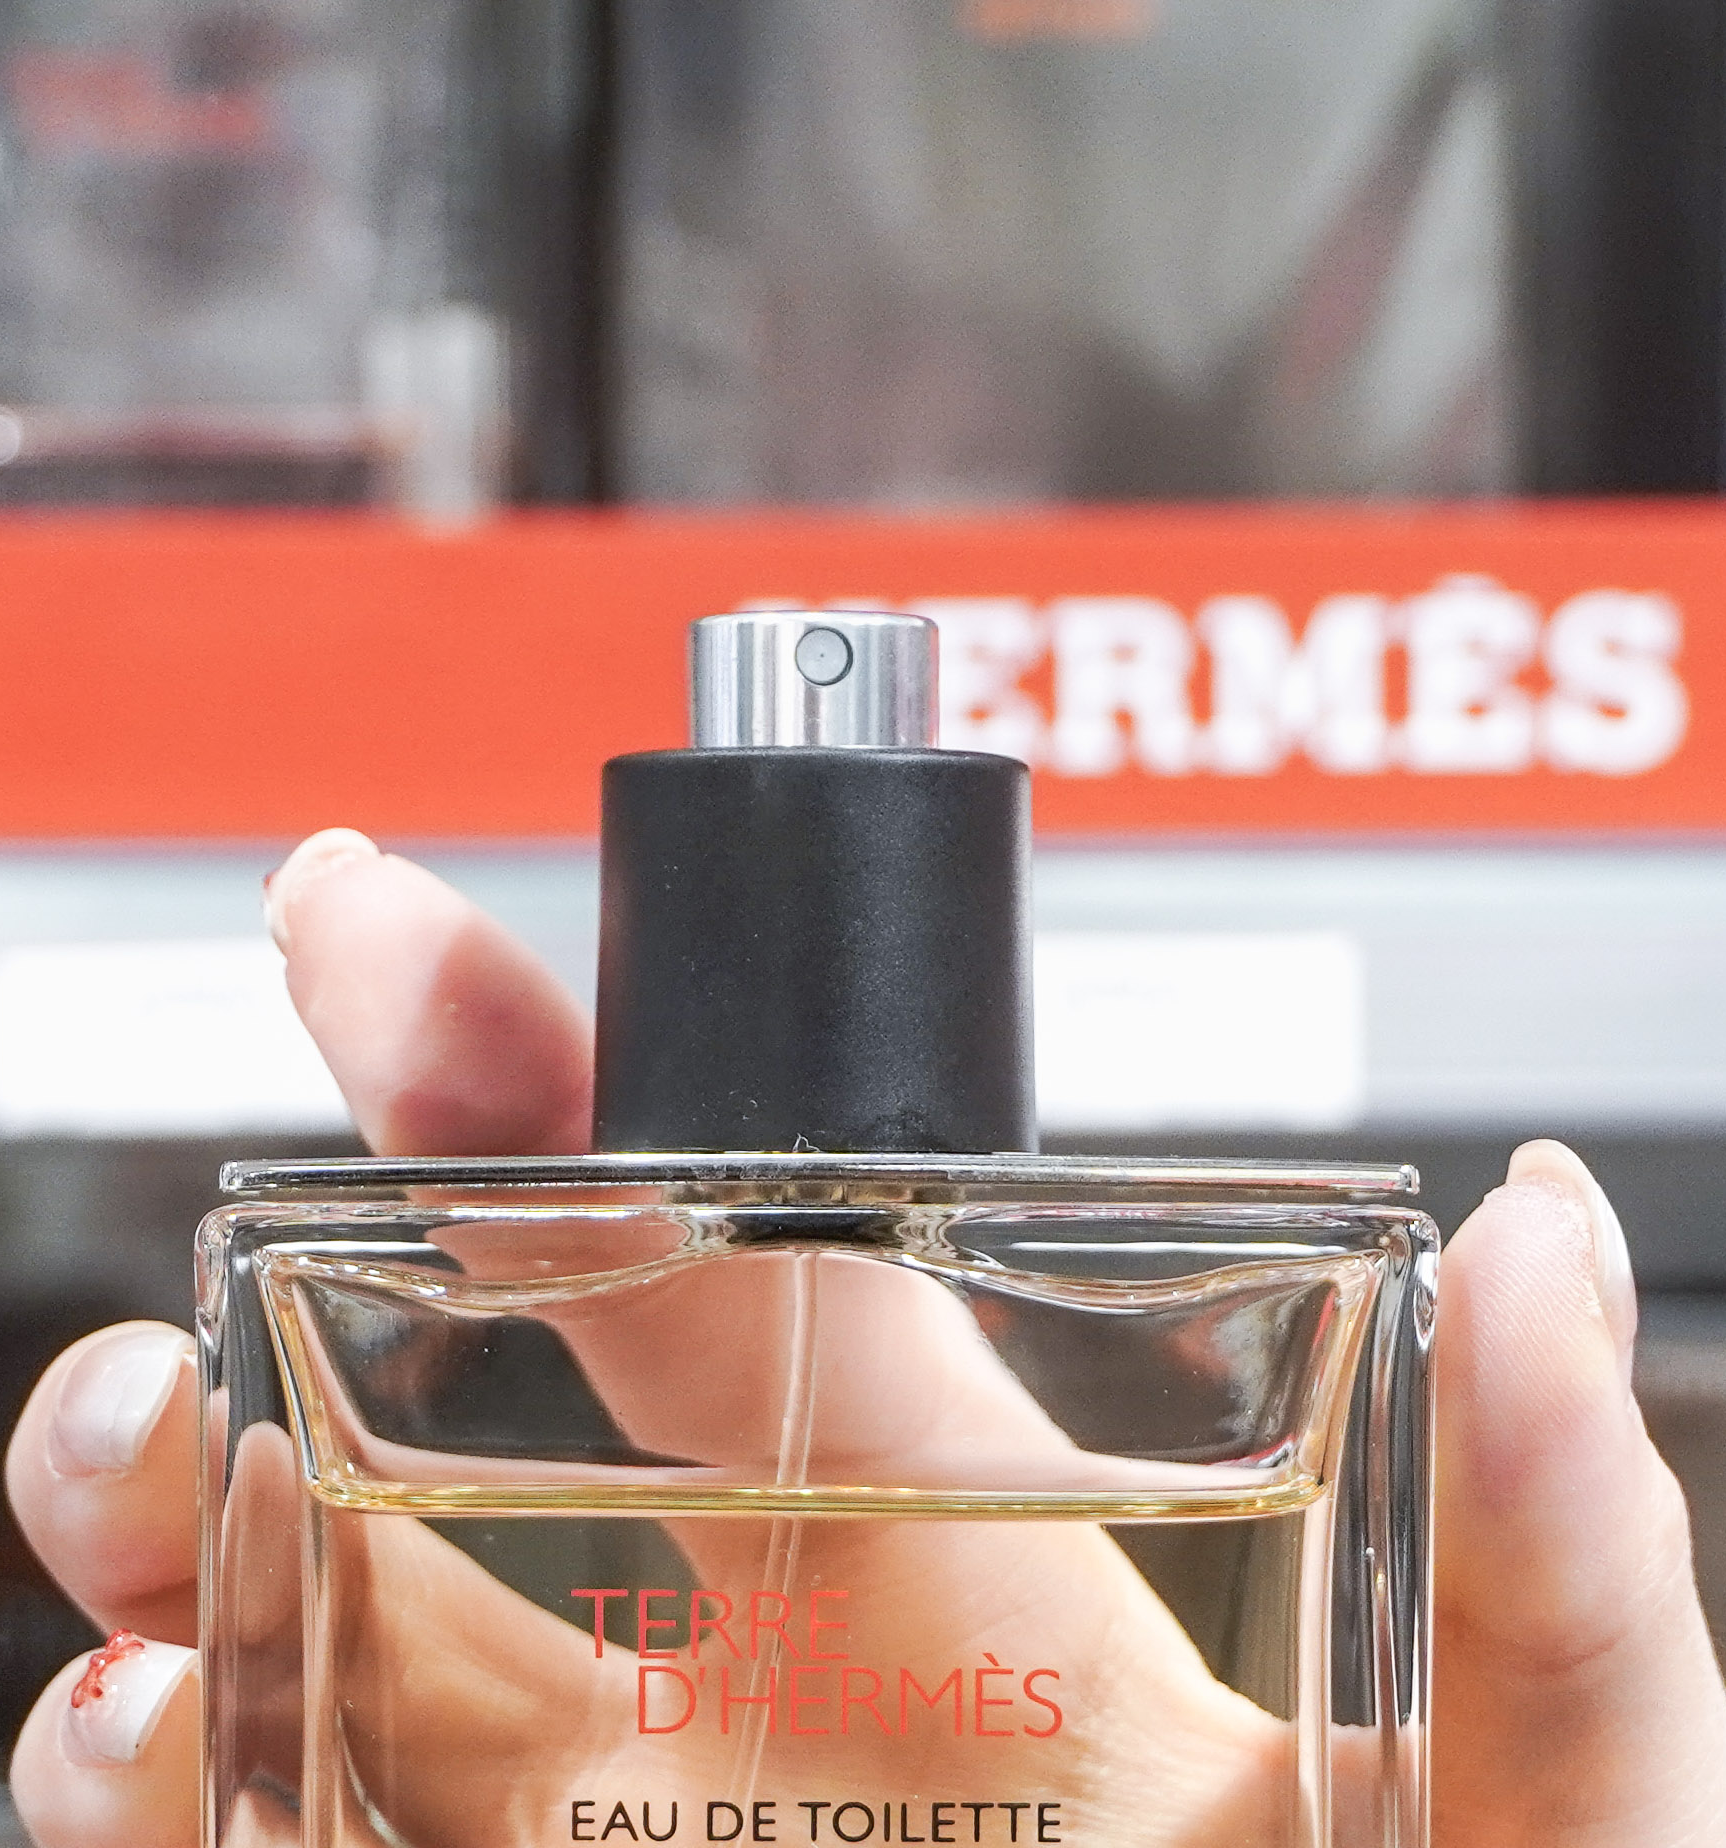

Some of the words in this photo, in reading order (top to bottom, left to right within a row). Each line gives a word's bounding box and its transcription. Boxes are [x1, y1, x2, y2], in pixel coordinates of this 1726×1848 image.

[737, 572, 1690, 778] ERMÈS
[571, 1588, 850, 1661] TERRE
[637, 1652, 1064, 1738] D'HERMÈS
[570, 1800, 678, 1843] EAU
[706, 1800, 777, 1843] DE
[797, 1800, 1063, 1844] TOILETTE
